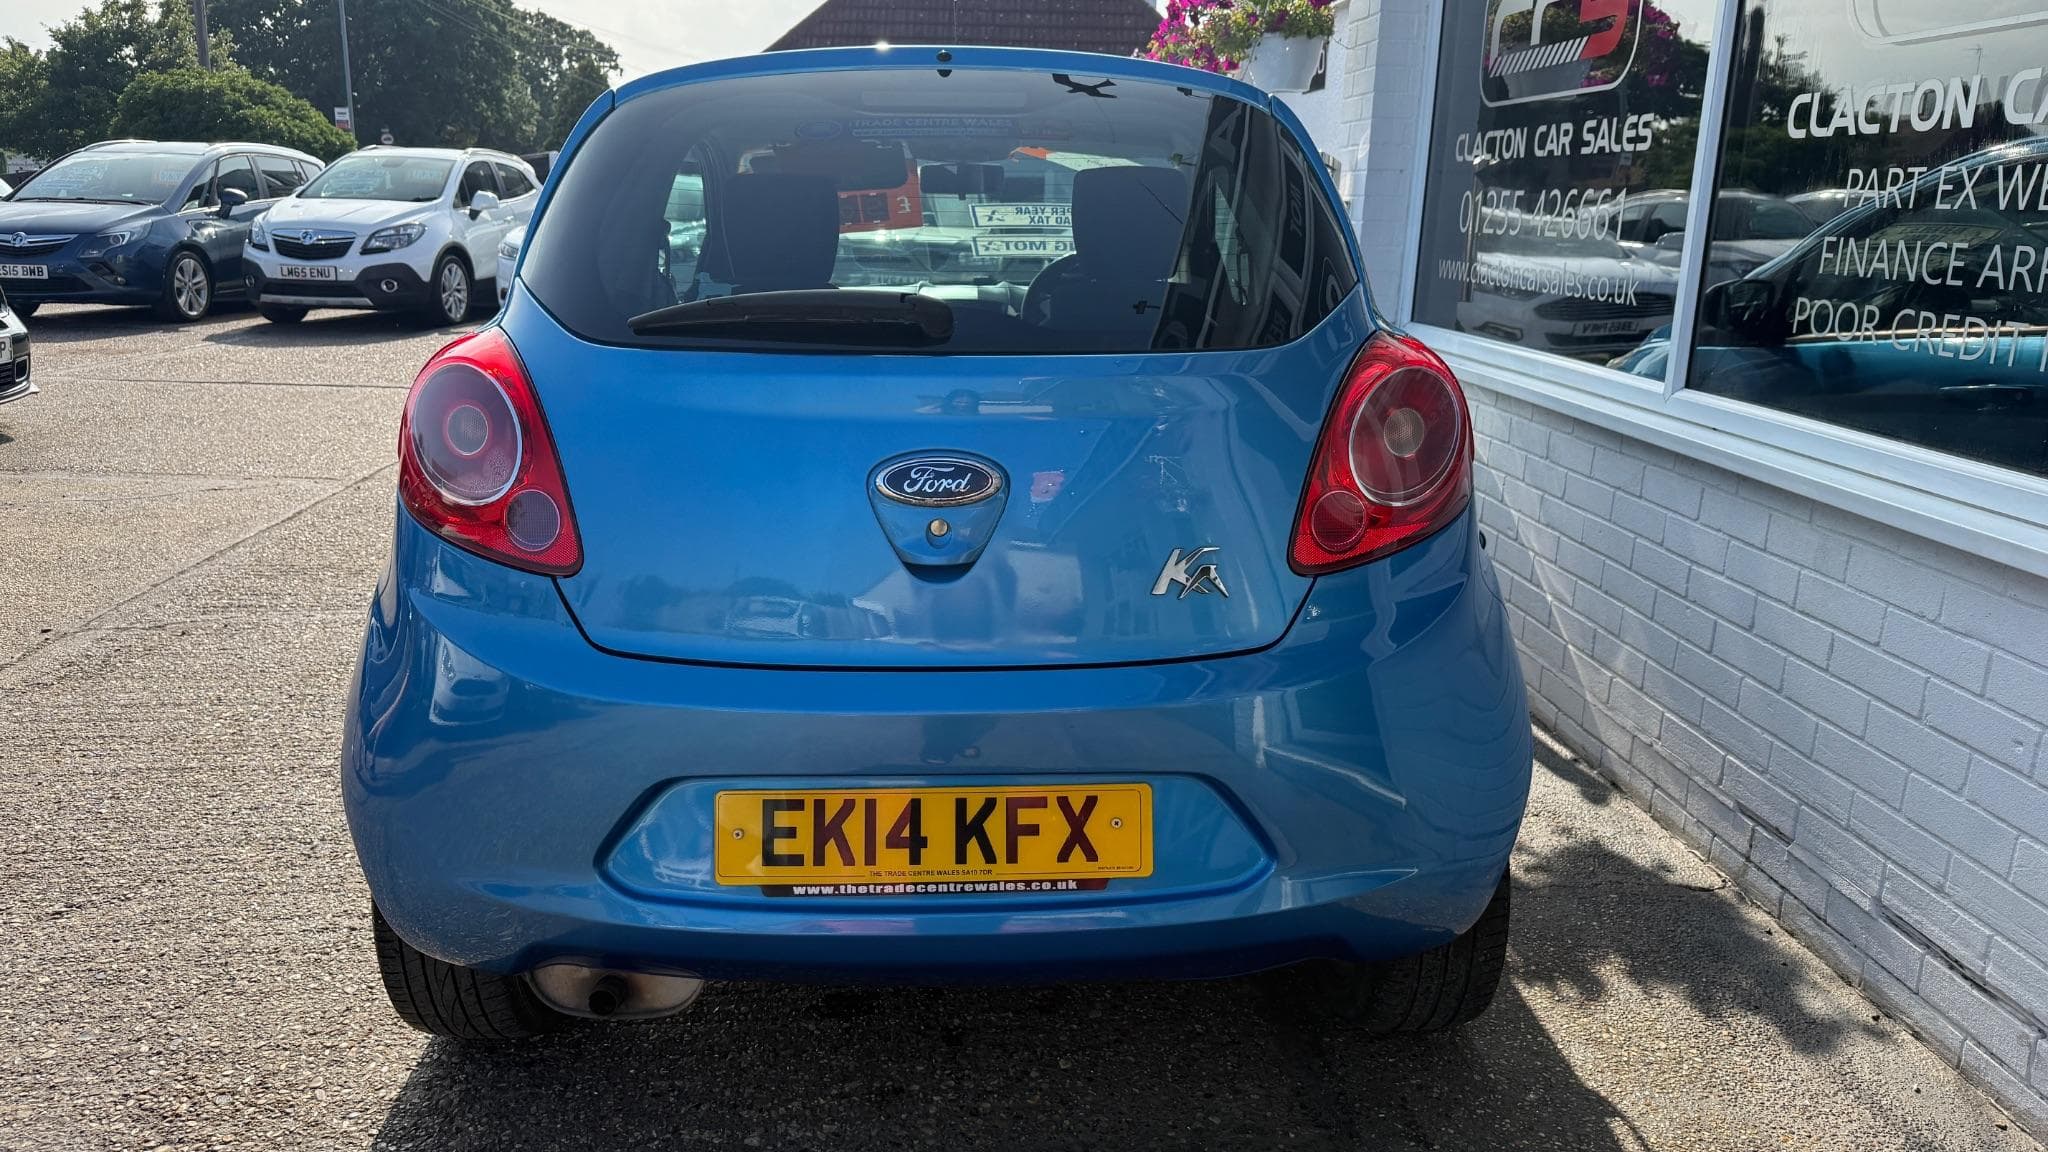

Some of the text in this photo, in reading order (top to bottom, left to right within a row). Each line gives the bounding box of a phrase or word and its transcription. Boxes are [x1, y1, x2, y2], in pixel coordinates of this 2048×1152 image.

[1787, 75, 1982, 139] CLACTON
[1455, 113, 1654, 162] CLACTON CAR SALES
[1844, 167, 1927, 209] PART
[1935, 166, 1985, 210] EX
[1460, 187, 1627, 240] 01255 426661
[0, 265, 19, 276] S15
[1438, 257, 1640, 306] www.clactoncarsales.co.uk
[1819, 236, 1969, 286] FINANCE
[1793, 297, 1880, 345] POOR
[1891, 308, 2030, 368] CREDIT
[903, 466, 972, 493] Ford
[762, 795, 1099, 866] EK14 KFX
[793, 879, 1079, 895] www.thetradecentrewales.co.uk
[908, 869, 934, 877] CENTRE
